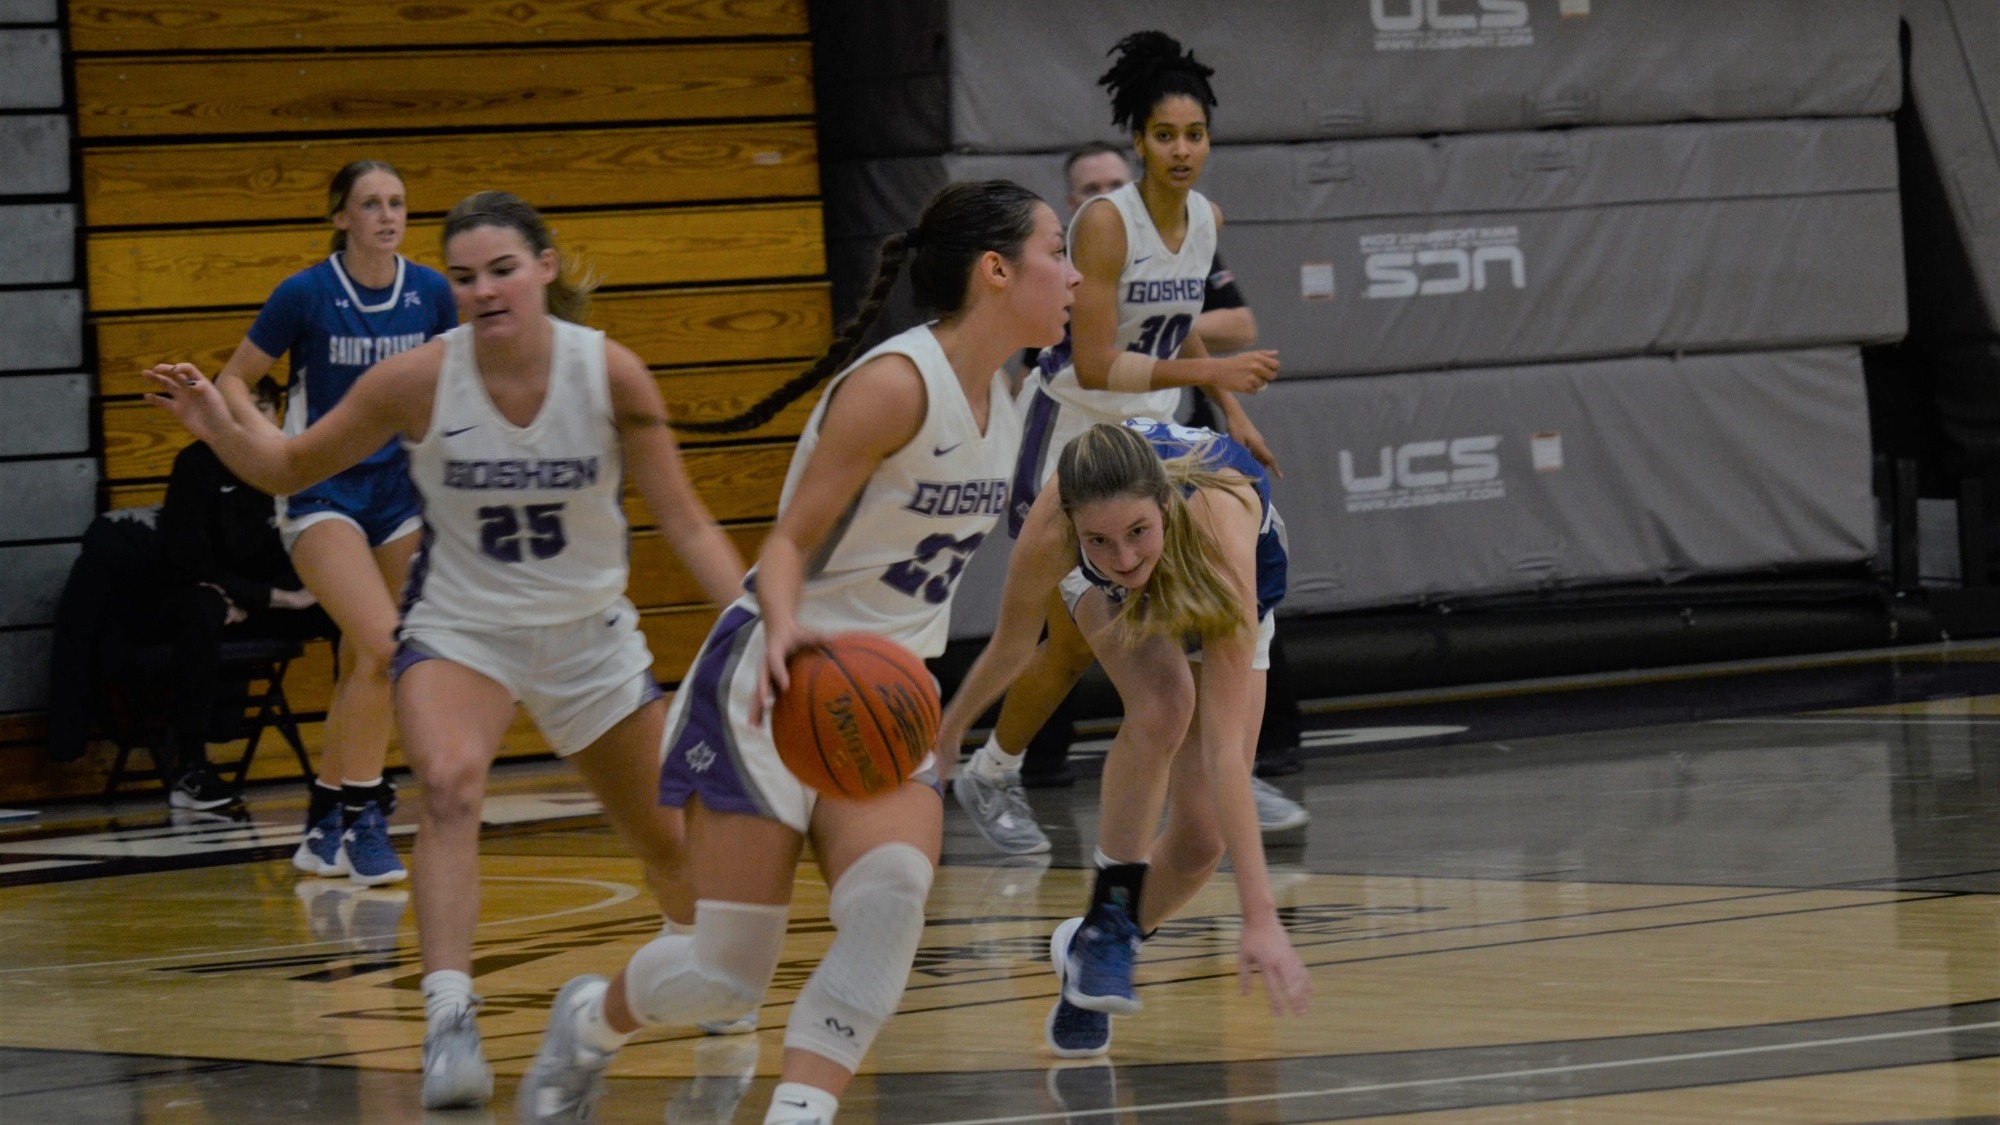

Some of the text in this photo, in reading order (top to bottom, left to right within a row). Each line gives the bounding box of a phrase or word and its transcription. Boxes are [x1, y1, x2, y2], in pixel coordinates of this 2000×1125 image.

[1371, 0, 1529, 30] UCS
[1364, 246, 1526, 298] UCS
[329, 335, 373, 365] SAINT
[1126, 314, 1192, 360] 30
[445, 457, 598, 489] GOSHEN
[1340, 434, 1502, 493] UCS
[905, 479, 1008, 518] GOSHE
[478, 503, 566, 562] 25
